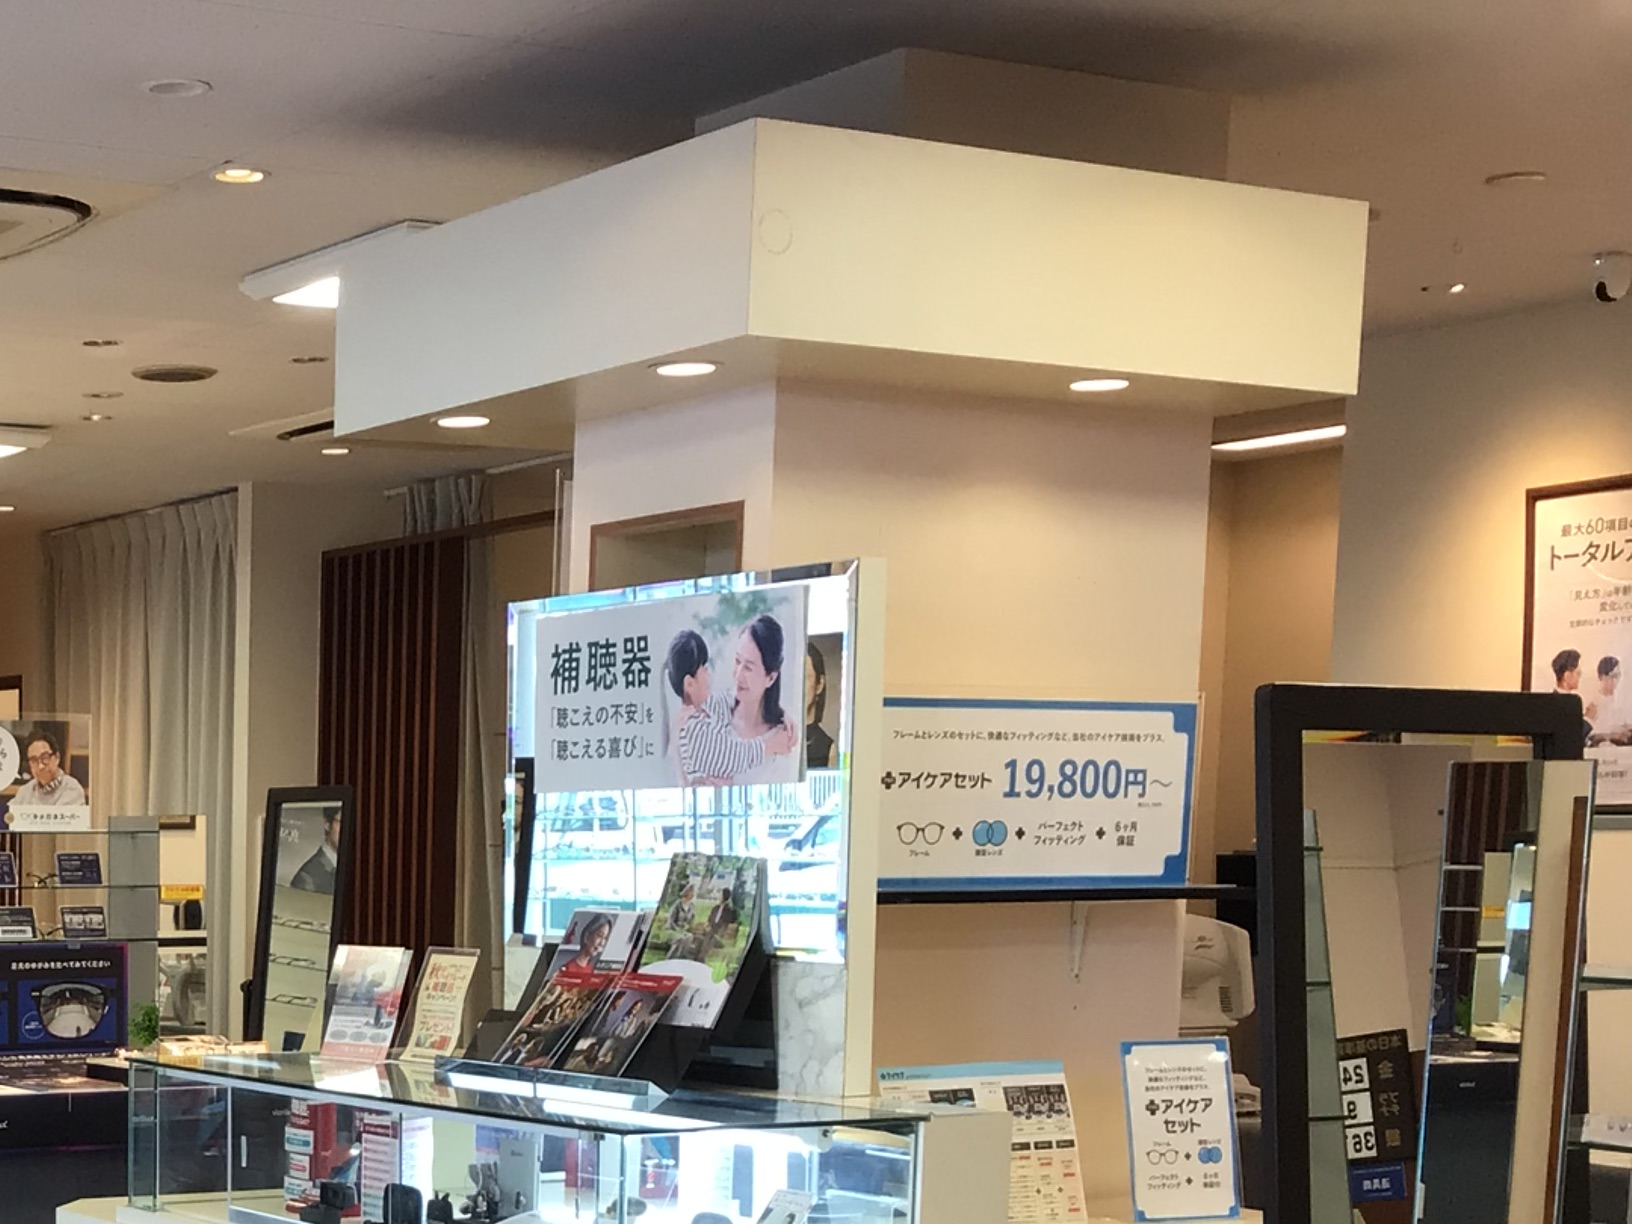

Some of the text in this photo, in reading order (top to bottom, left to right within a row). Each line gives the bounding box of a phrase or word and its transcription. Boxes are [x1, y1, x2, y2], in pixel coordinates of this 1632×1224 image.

[1561, 517, 1632, 537] 最大60項目
[550, 635, 652, 696] 補聴器
[550, 702, 655, 729] 「聴こえの不安」を
[550, 735, 655, 760] 「聴こえる喜び」に
[898, 771, 993, 789] アイケアセット
[1037, 821, 1085, 832] パーフェクト
[1034, 835, 1086, 846] フィッティング
[1116, 835, 1136, 846] 保証
[1160, 1098, 1214, 1115] アイケア
[1163, 1117, 1202, 1134] セット
